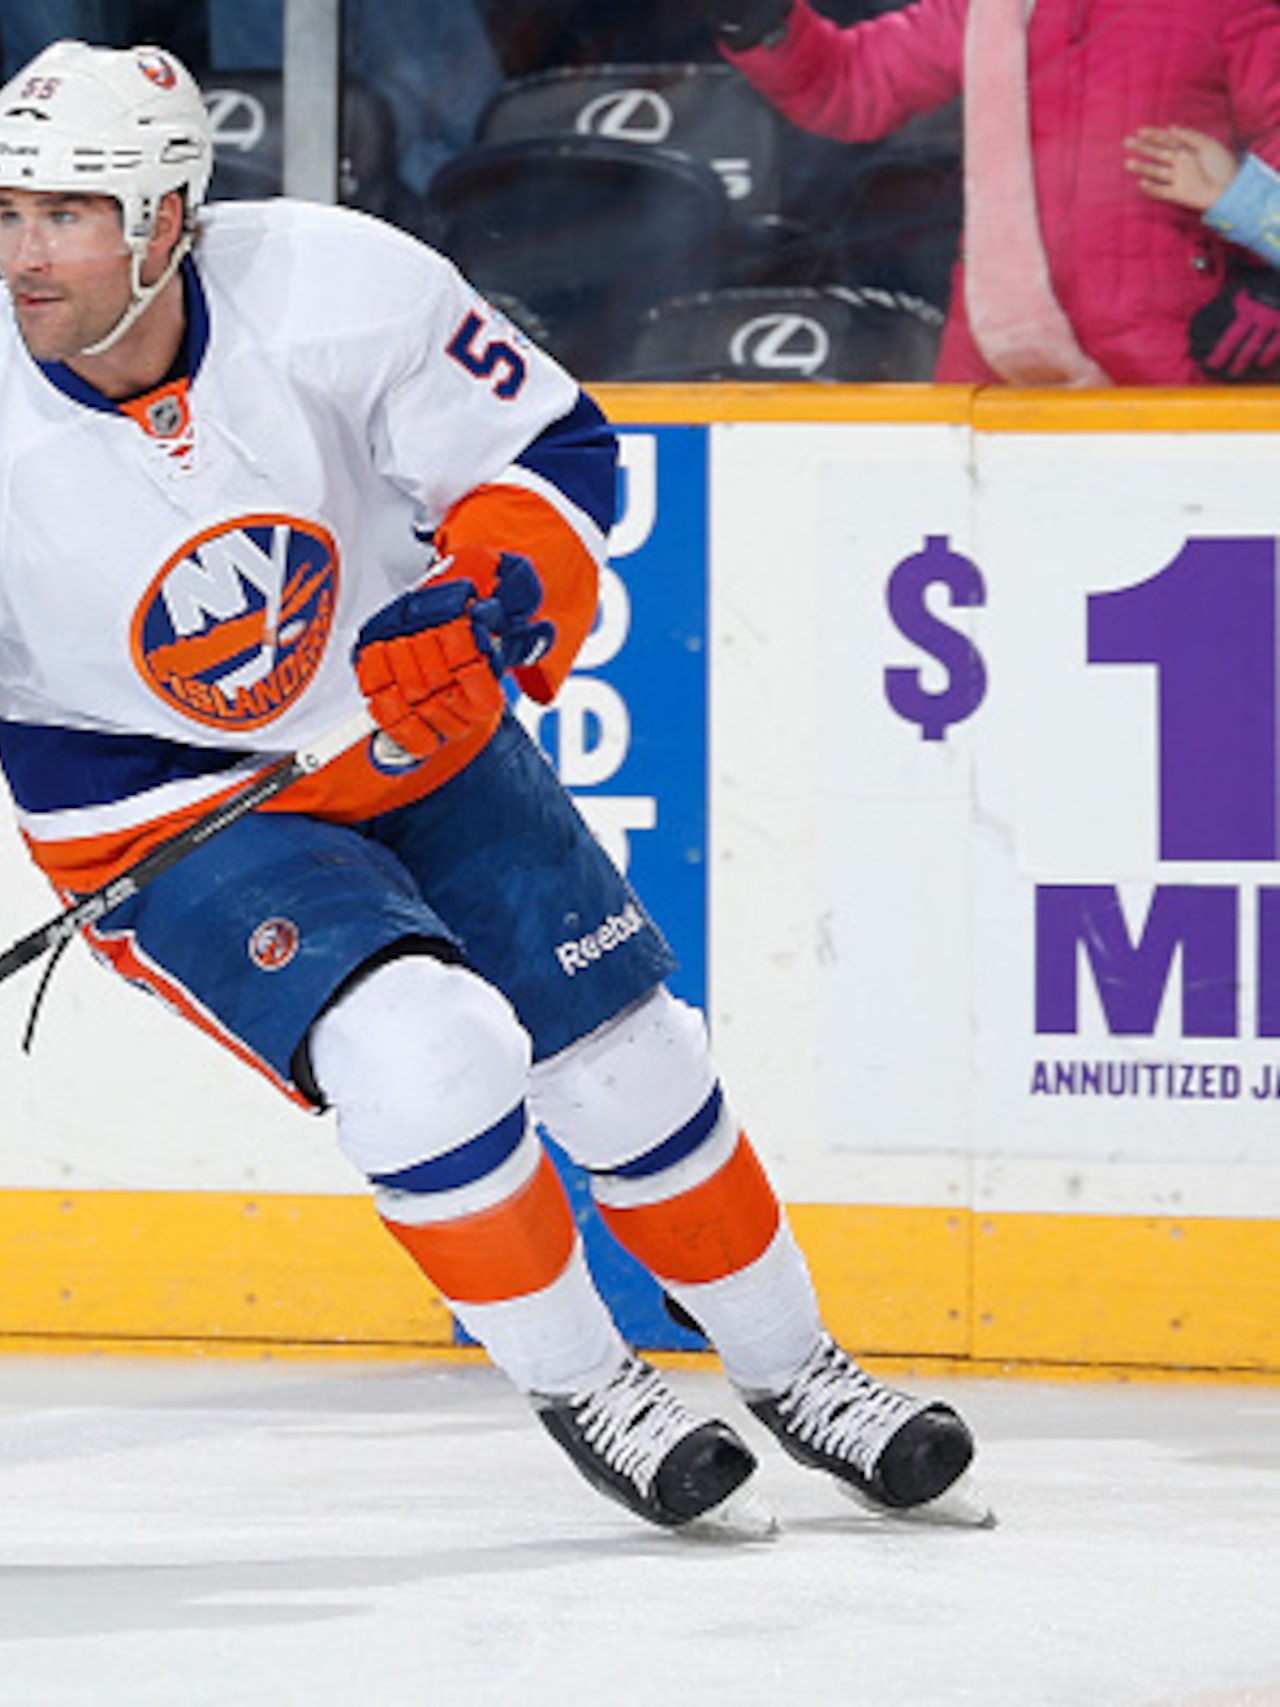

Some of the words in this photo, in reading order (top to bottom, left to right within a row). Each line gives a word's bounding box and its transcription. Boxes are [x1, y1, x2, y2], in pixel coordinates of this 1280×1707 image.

[444, 305, 532, 401] 5
[554, 902, 643, 977] Reeb
[1030, 1060, 1241, 1100] ANNUITIZED
[1251, 1064, 1280, 1100] J
